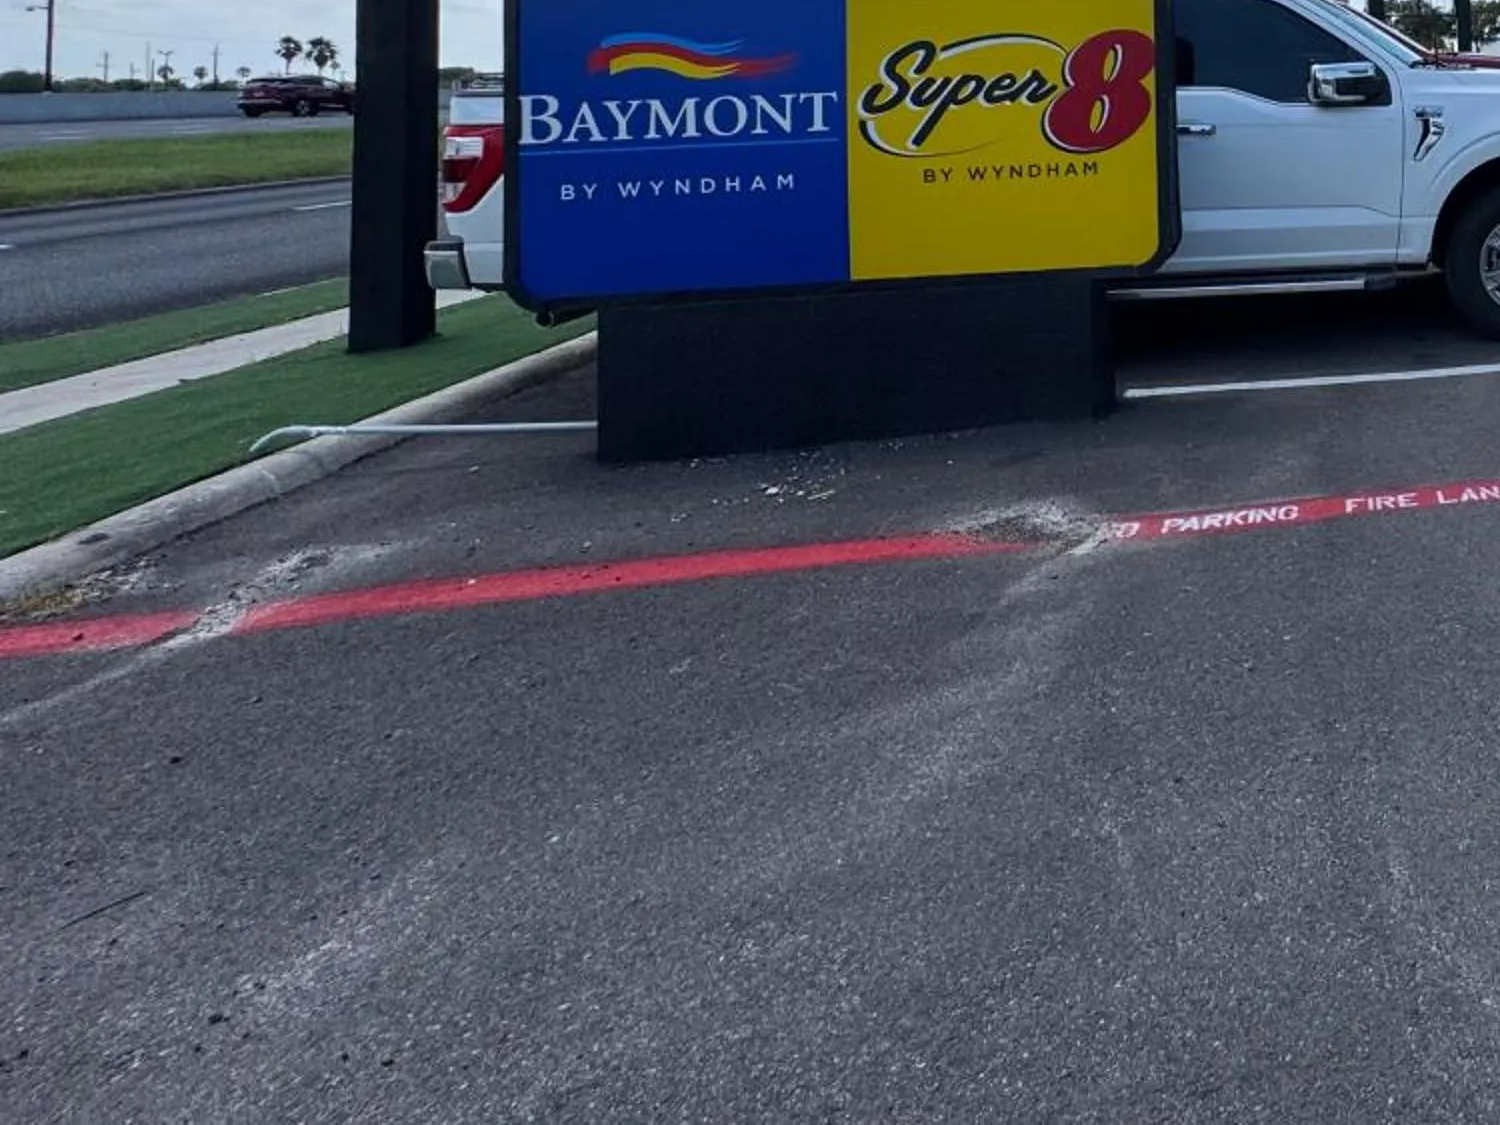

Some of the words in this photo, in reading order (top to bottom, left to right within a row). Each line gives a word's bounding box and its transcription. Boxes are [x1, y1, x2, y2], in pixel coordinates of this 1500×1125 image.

[860, 39, 1058, 151] Super
[1042, 28, 1154, 153] 8
[518, 89, 838, 146] BAYMONT
[560, 183, 597, 201] BY
[618, 174, 796, 199] WYNDHAM
[923, 167, 956, 184] BY
[968, 161, 1099, 180] WYNDHAM
[1160, 504, 1300, 534] PARKING
[1344, 491, 1418, 514] FIRE
